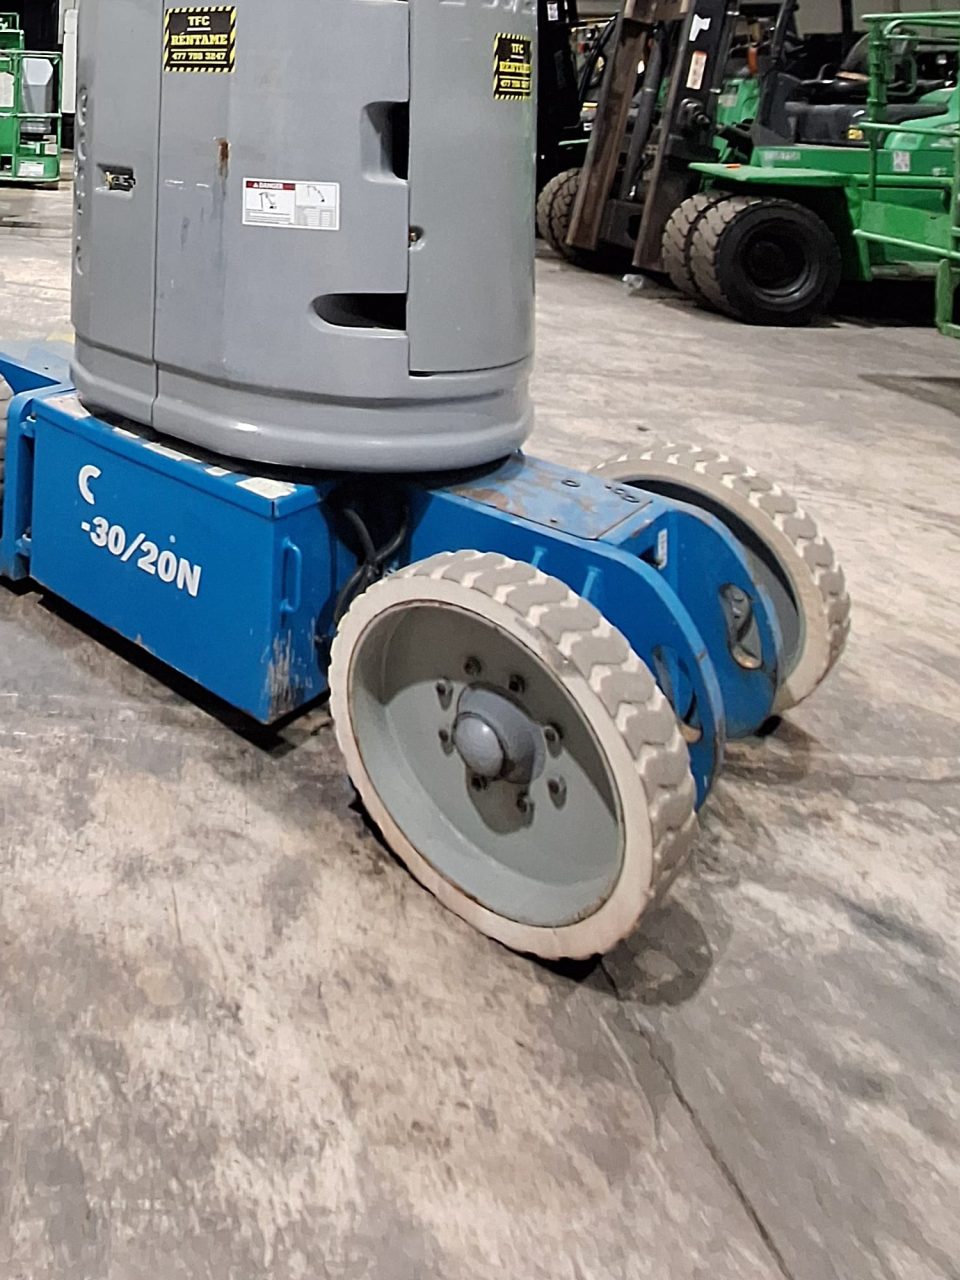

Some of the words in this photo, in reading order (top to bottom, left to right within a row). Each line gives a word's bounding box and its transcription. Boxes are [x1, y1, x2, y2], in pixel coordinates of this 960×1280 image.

[187, 15, 210, 26] TFC
[170, 32, 228, 46] RÉNTAME
[511, 43, 524, 54] TFC
[81, 516, 202, 598] -30/20N
